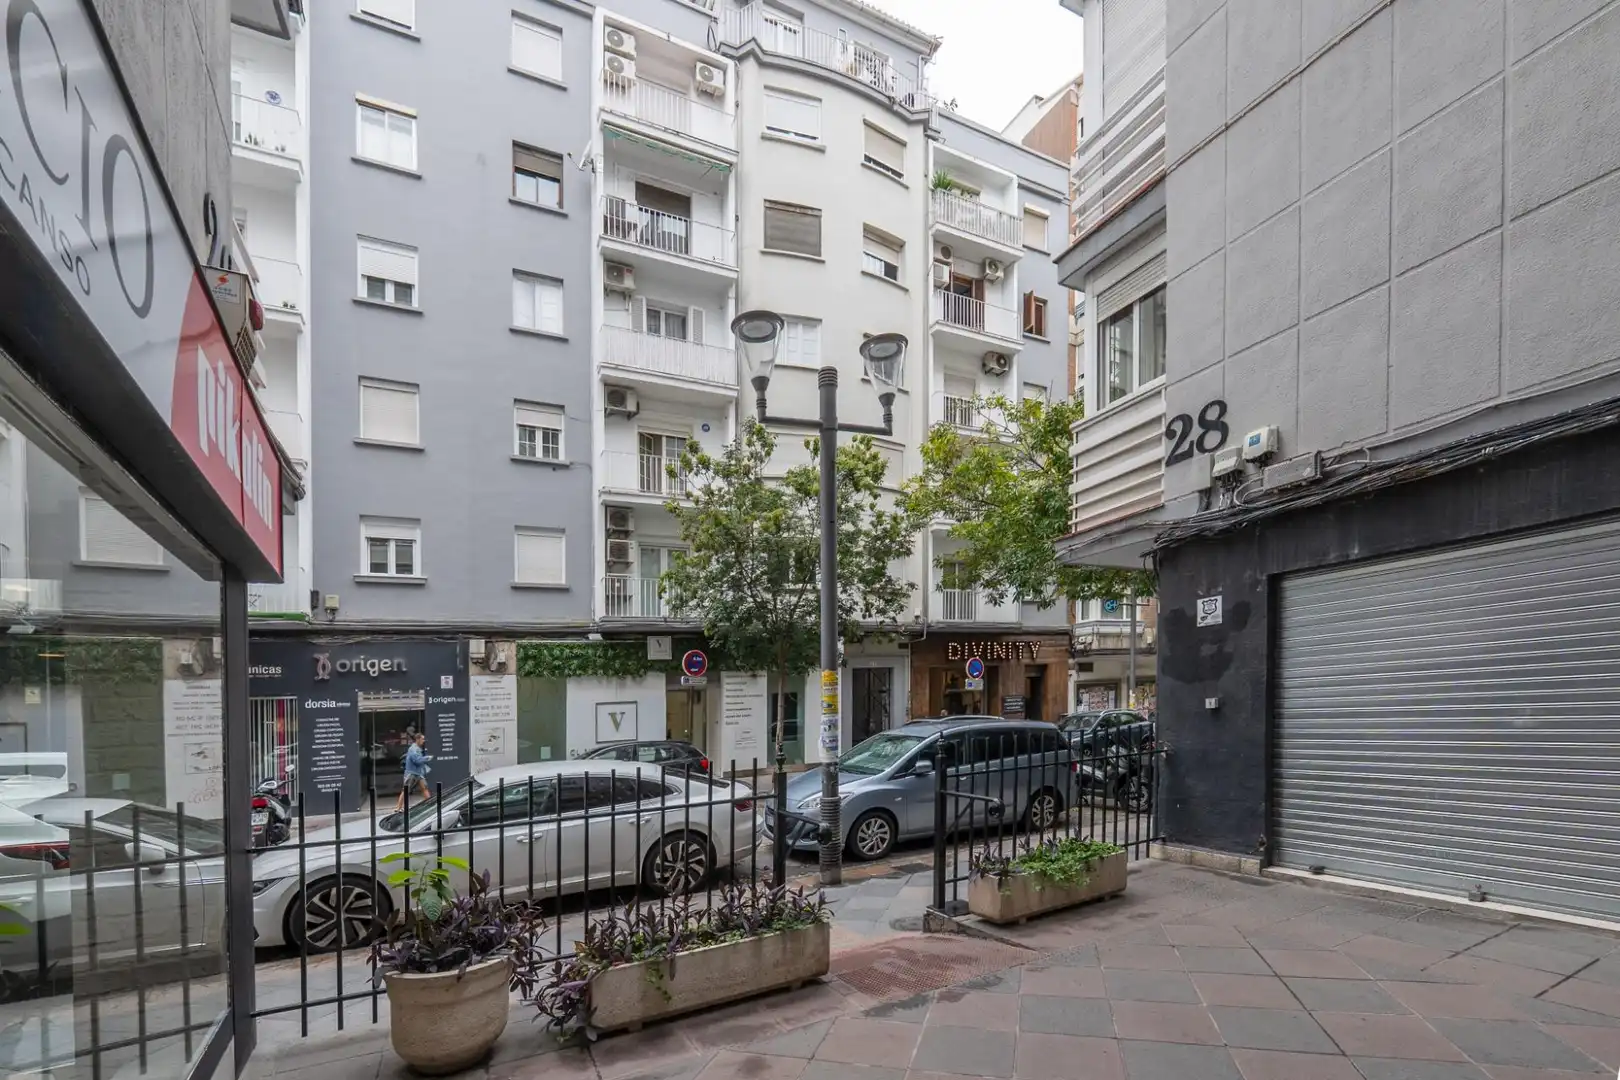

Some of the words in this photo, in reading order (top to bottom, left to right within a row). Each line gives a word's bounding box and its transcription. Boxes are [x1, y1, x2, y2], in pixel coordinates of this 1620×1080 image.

[1165, 400, 1229, 467] 28
[948, 642, 1040, 660] DIVINITY
[336, 655, 408, 677] origen
[304, 698, 336, 709] dorsia
[433, 696, 456, 704] origen
[608, 711, 625, 733] V
